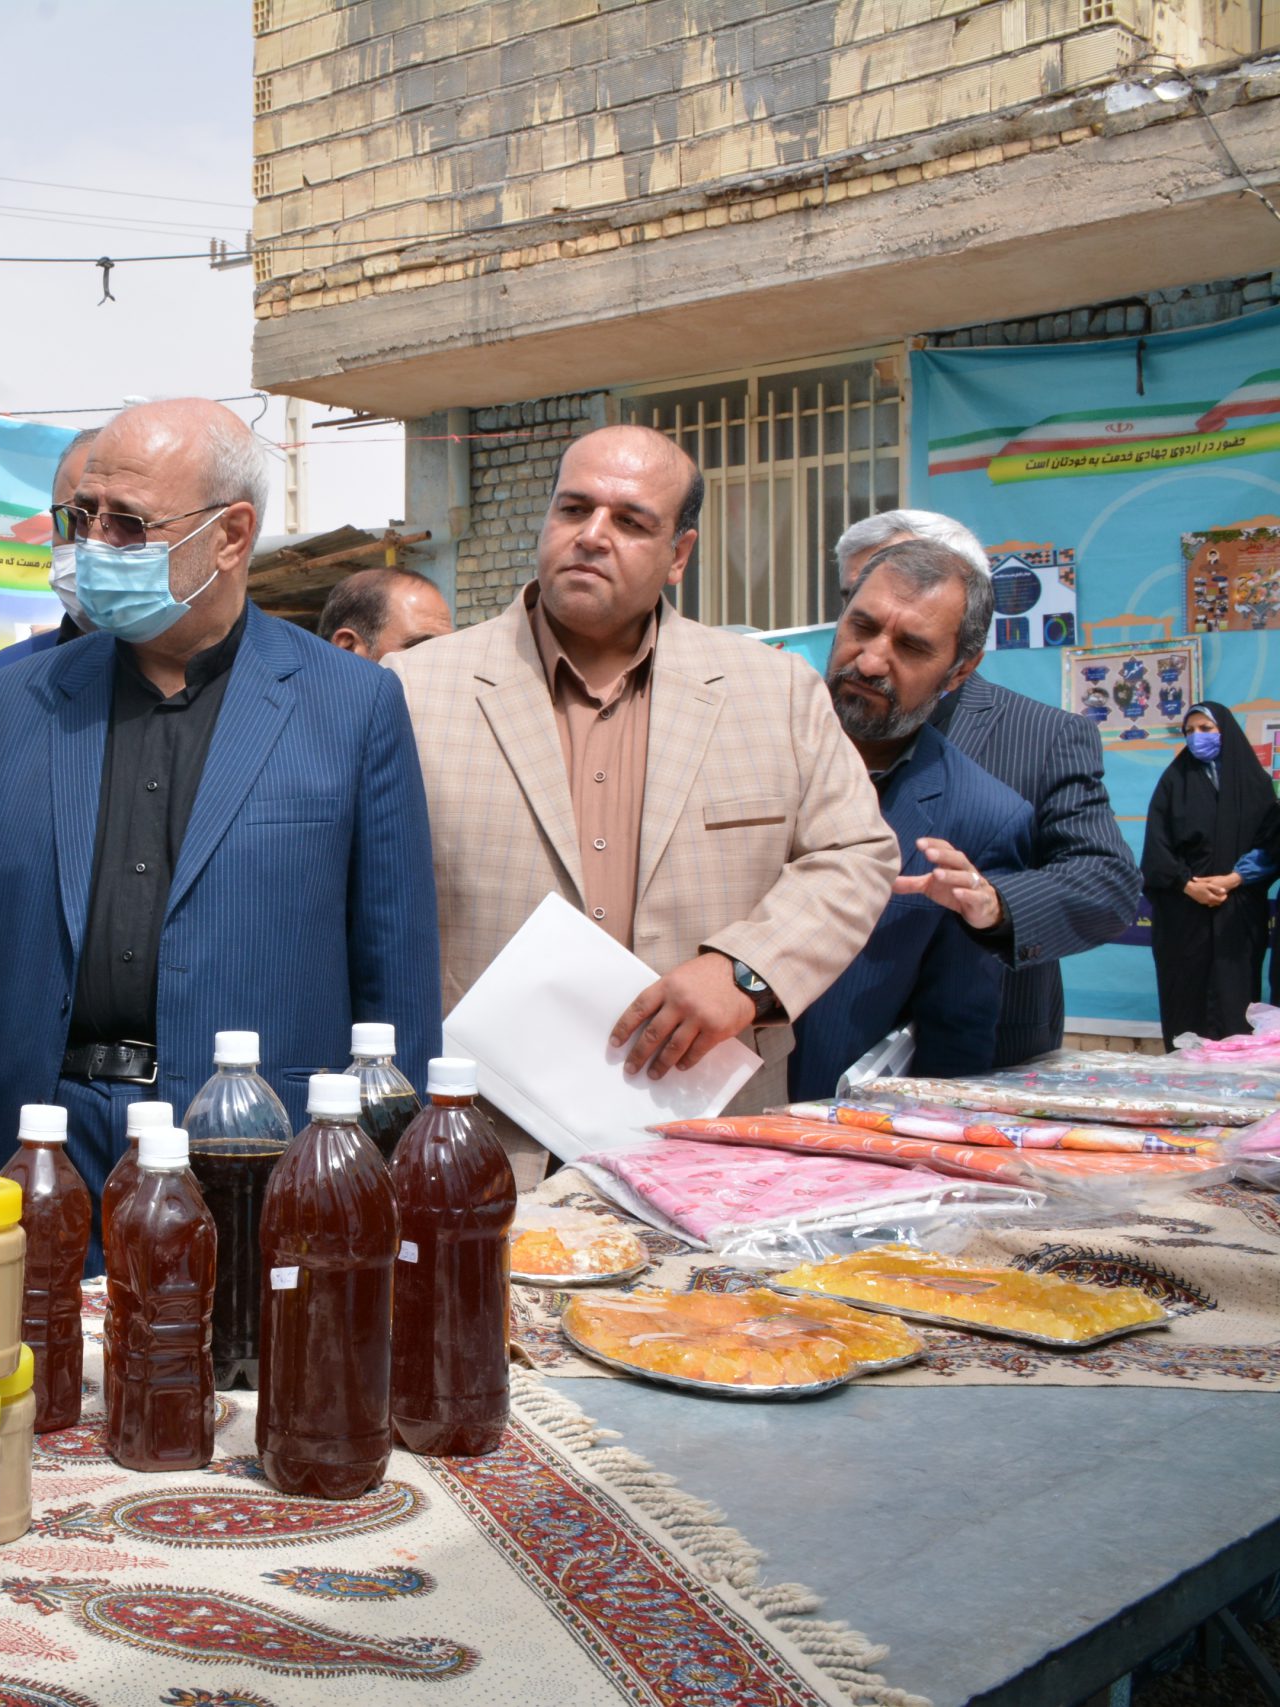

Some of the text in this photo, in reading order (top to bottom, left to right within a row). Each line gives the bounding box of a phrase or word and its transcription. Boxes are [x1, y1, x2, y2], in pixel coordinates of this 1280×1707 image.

[1025, 436, 1245, 470] حضور در اردوی جهادی خدمت به خودتان است
[17, 558, 40, 568] هست
